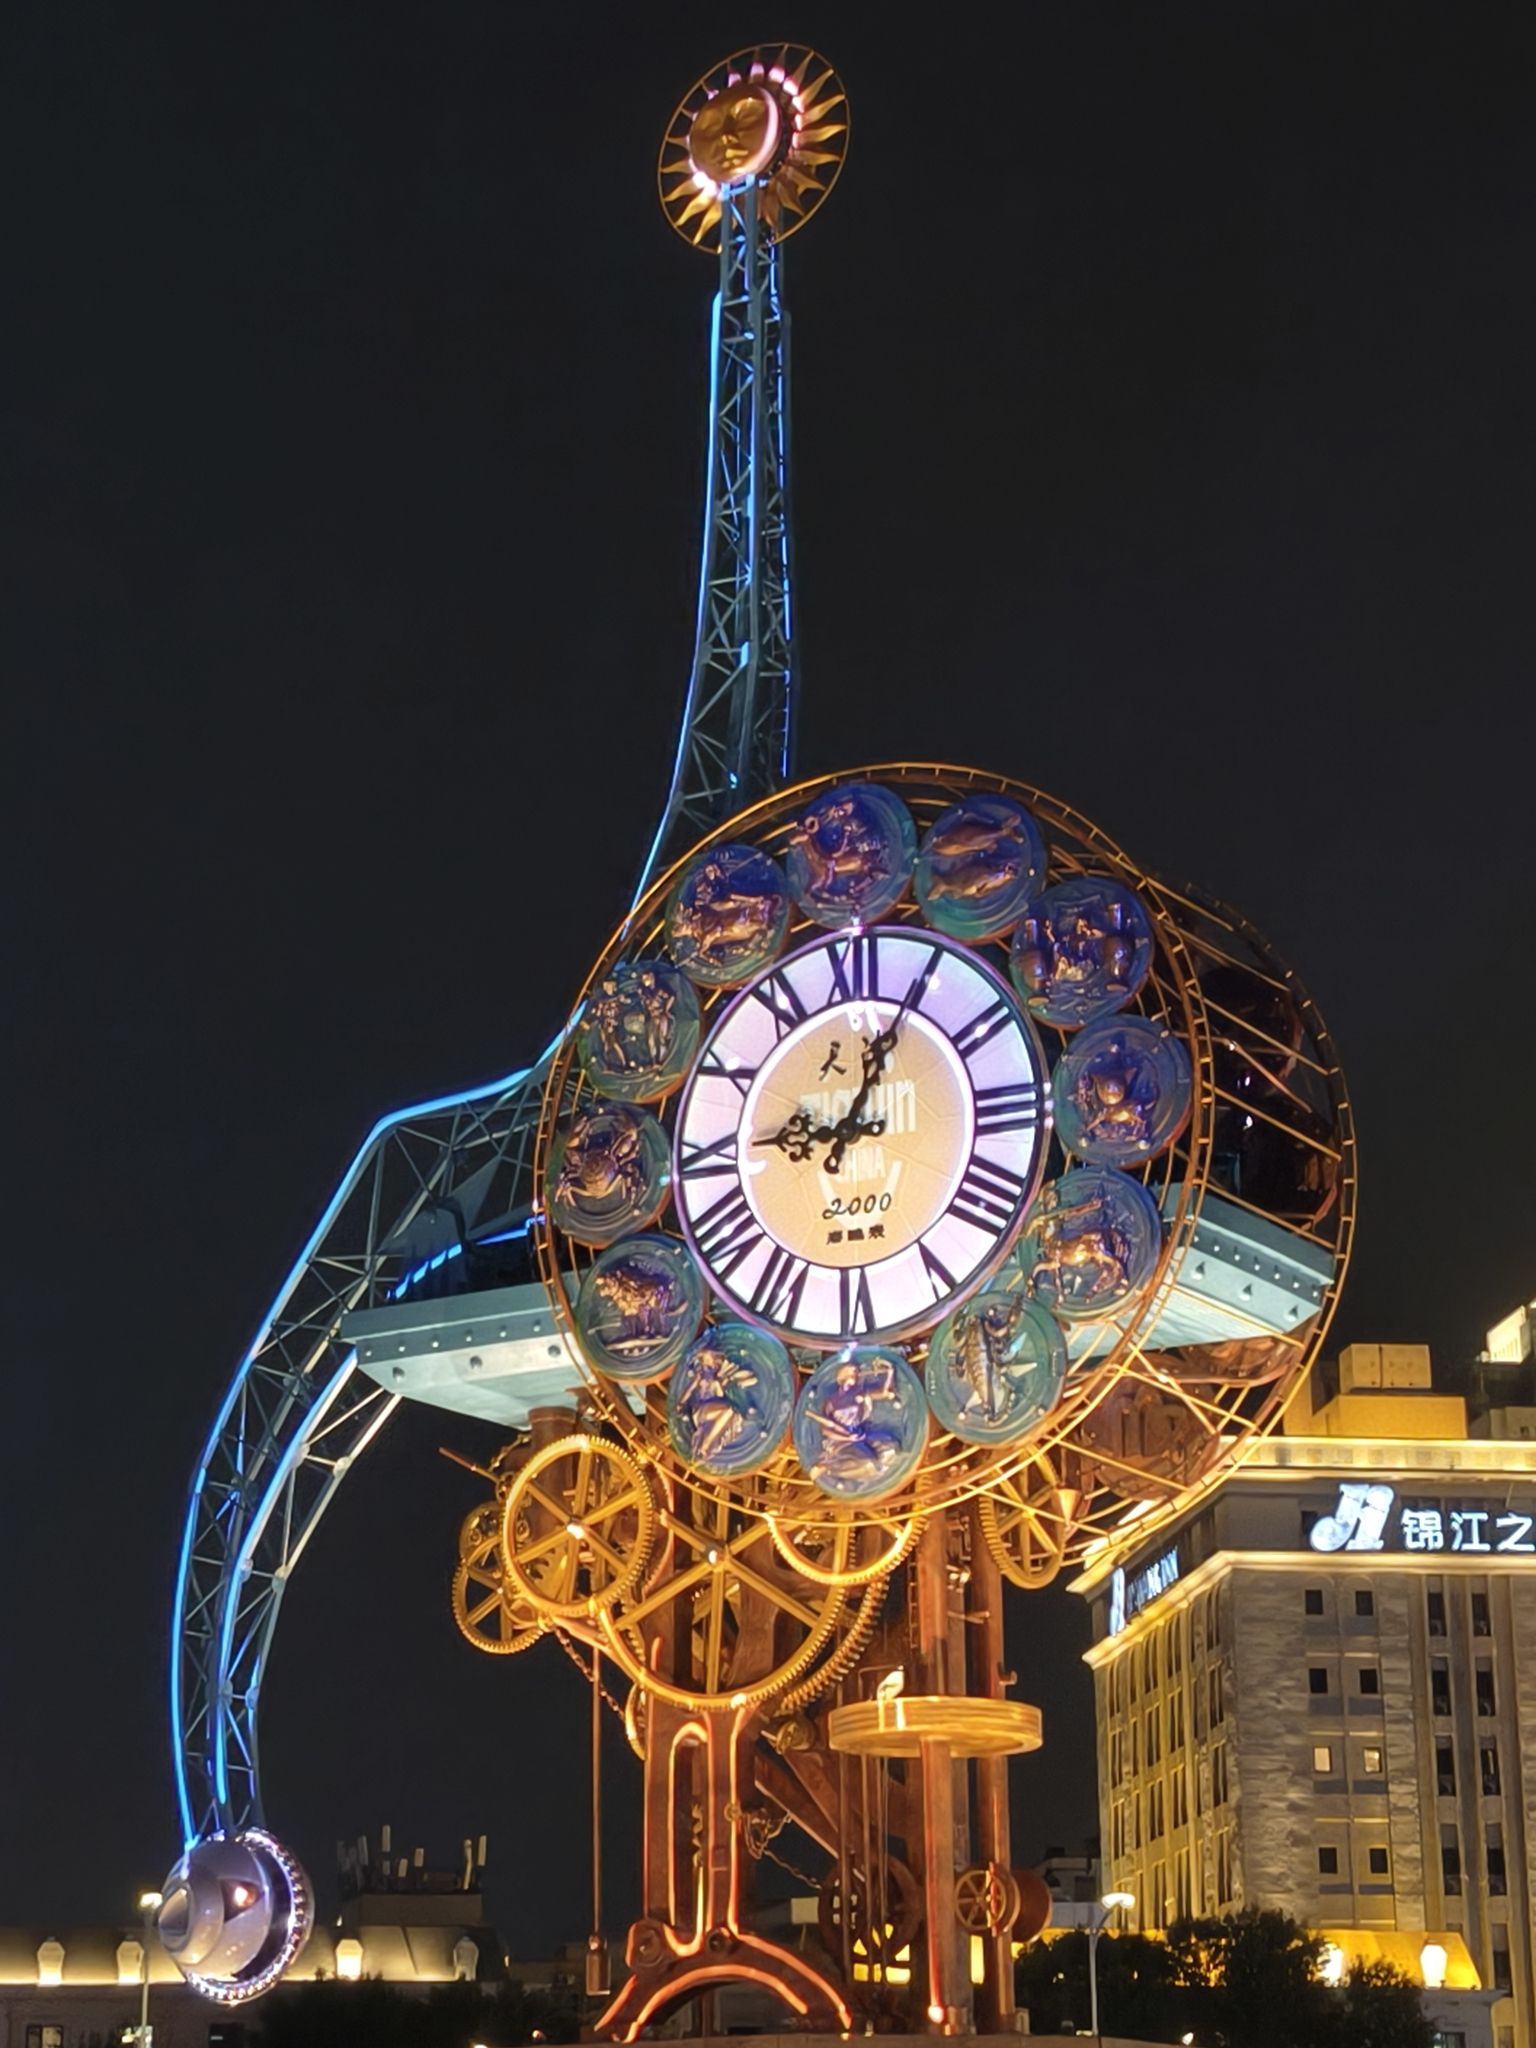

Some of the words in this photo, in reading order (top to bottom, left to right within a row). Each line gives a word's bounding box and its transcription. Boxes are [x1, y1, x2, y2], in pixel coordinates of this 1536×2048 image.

[822, 1192, 892, 1219] 2000
[1402, 1507, 1535, 1552] 锦江之
